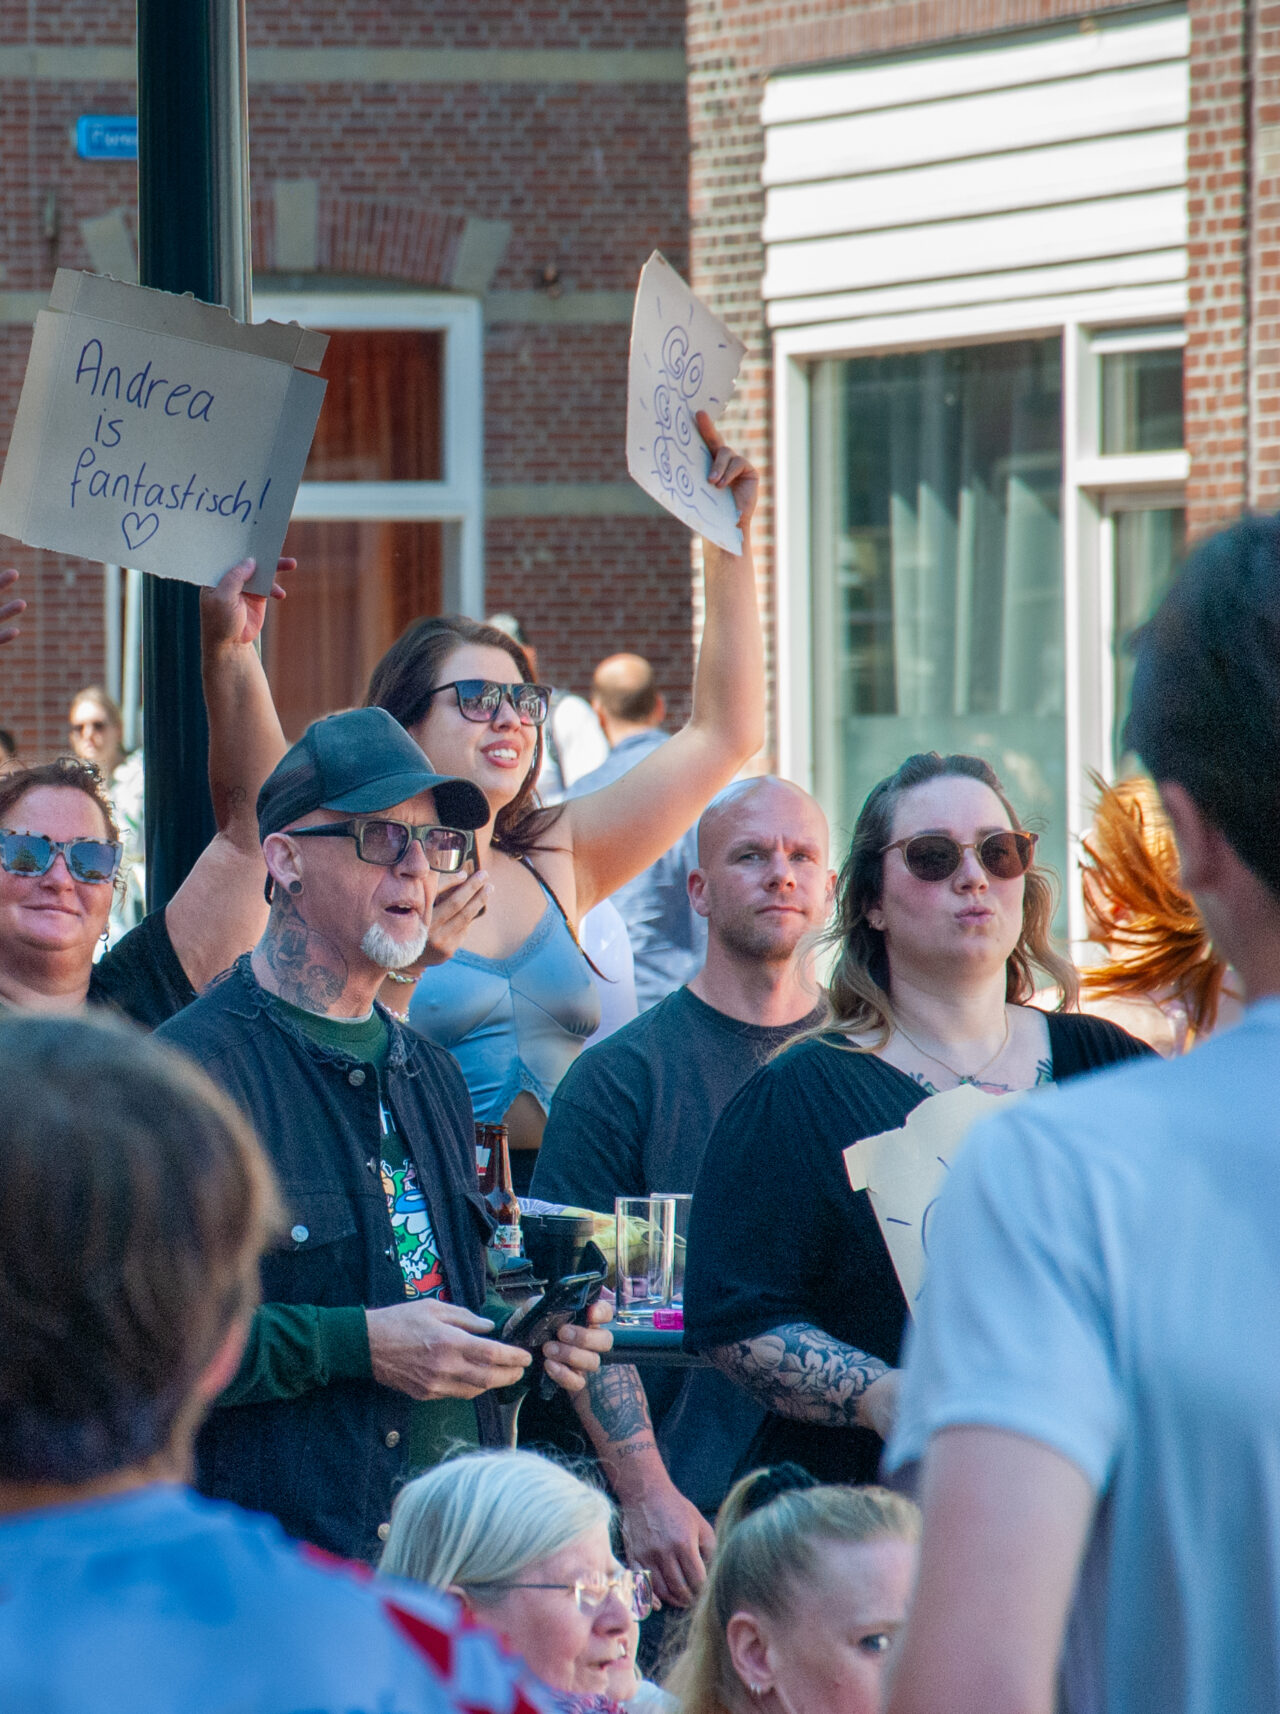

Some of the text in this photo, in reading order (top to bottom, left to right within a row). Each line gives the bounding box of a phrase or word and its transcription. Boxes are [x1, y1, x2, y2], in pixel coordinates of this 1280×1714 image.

[75, 338, 215, 422] Andrea
[662, 325, 705, 399] GO
[94, 408, 124, 447] is
[70, 447, 271, 524] fantastisch!
